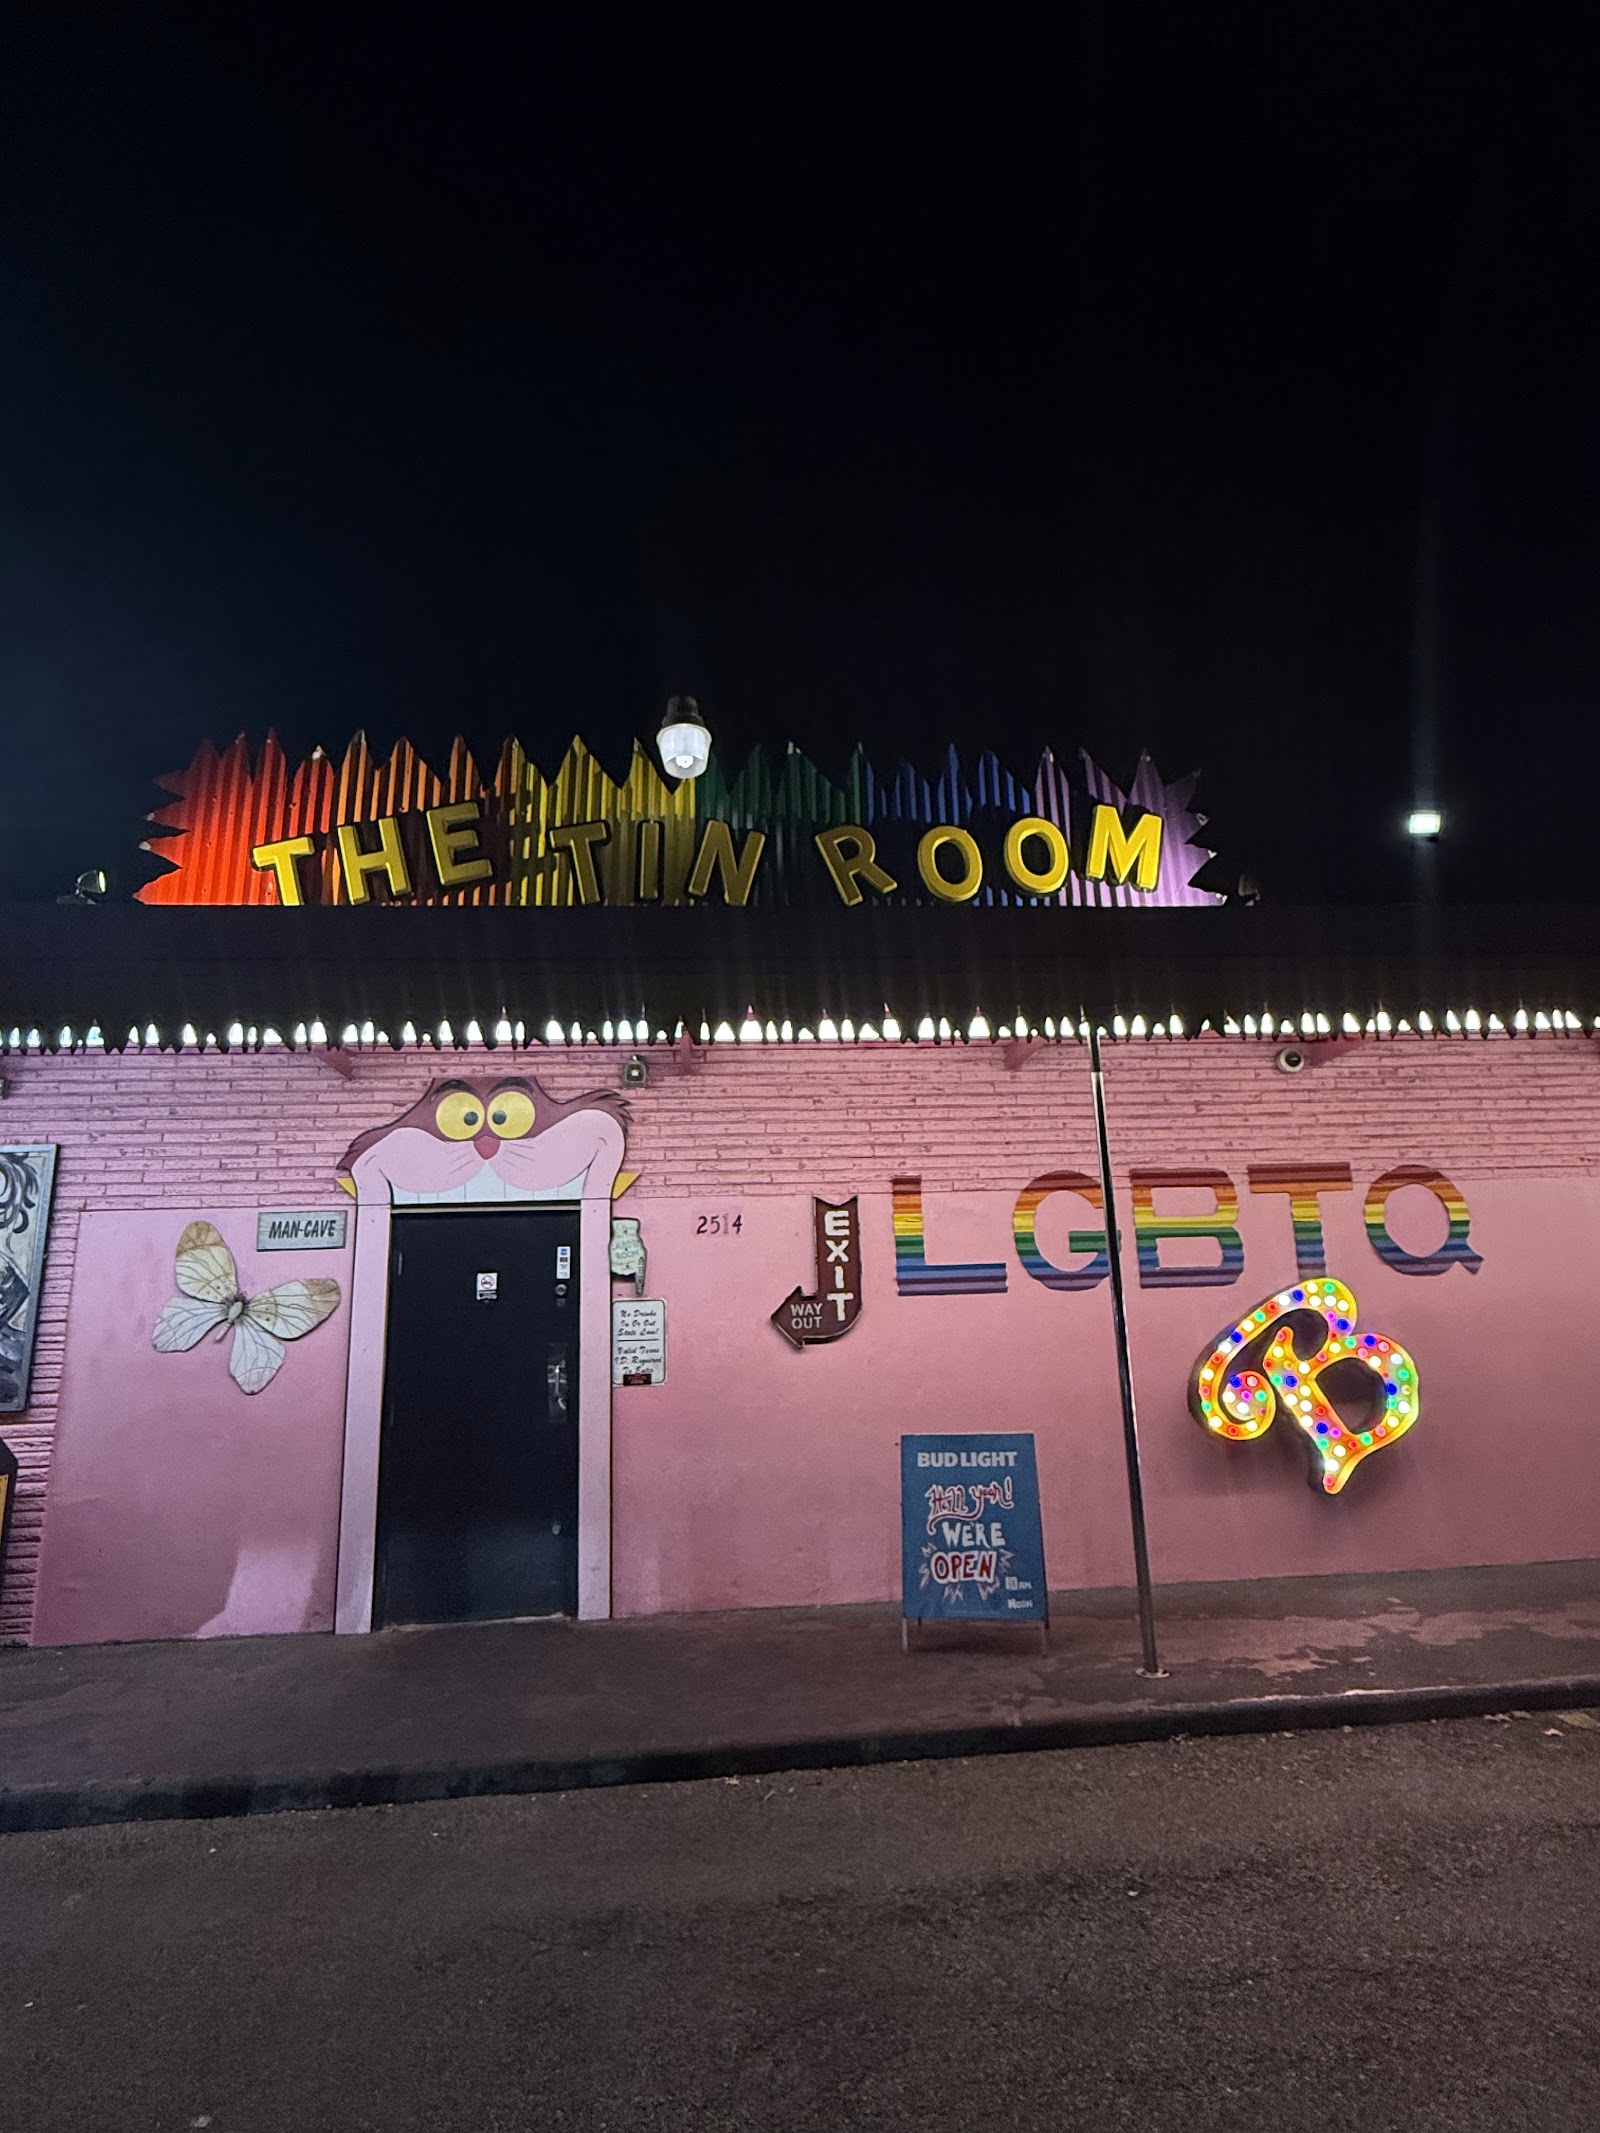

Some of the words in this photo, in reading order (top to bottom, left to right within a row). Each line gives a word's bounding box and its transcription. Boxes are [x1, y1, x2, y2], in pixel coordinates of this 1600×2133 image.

[252, 801, 493, 905] THE
[549, 819, 765, 906] TIN
[815, 804, 1162, 906] ROOM
[268, 1219, 337, 1239] MAN-CAVE
[696, 1213, 743, 1235] 2514
[890, 1162, 1485, 1296] LGBTQ
[824, 1210, 854, 1321] EXIT
[620, 1309, 631, 1318] No
[633, 1309, 656, 1318] Drinks
[790, 1303, 823, 1316] WAY
[632, 1319, 641, 1327] Or
[643, 1319, 657, 1327] Out
[791, 1316, 822, 1329] OUT
[917, 1452, 959, 1468] BUD
[960, 1451, 1018, 1468] LIGHT
[931, 1551, 998, 1584] OPEN
